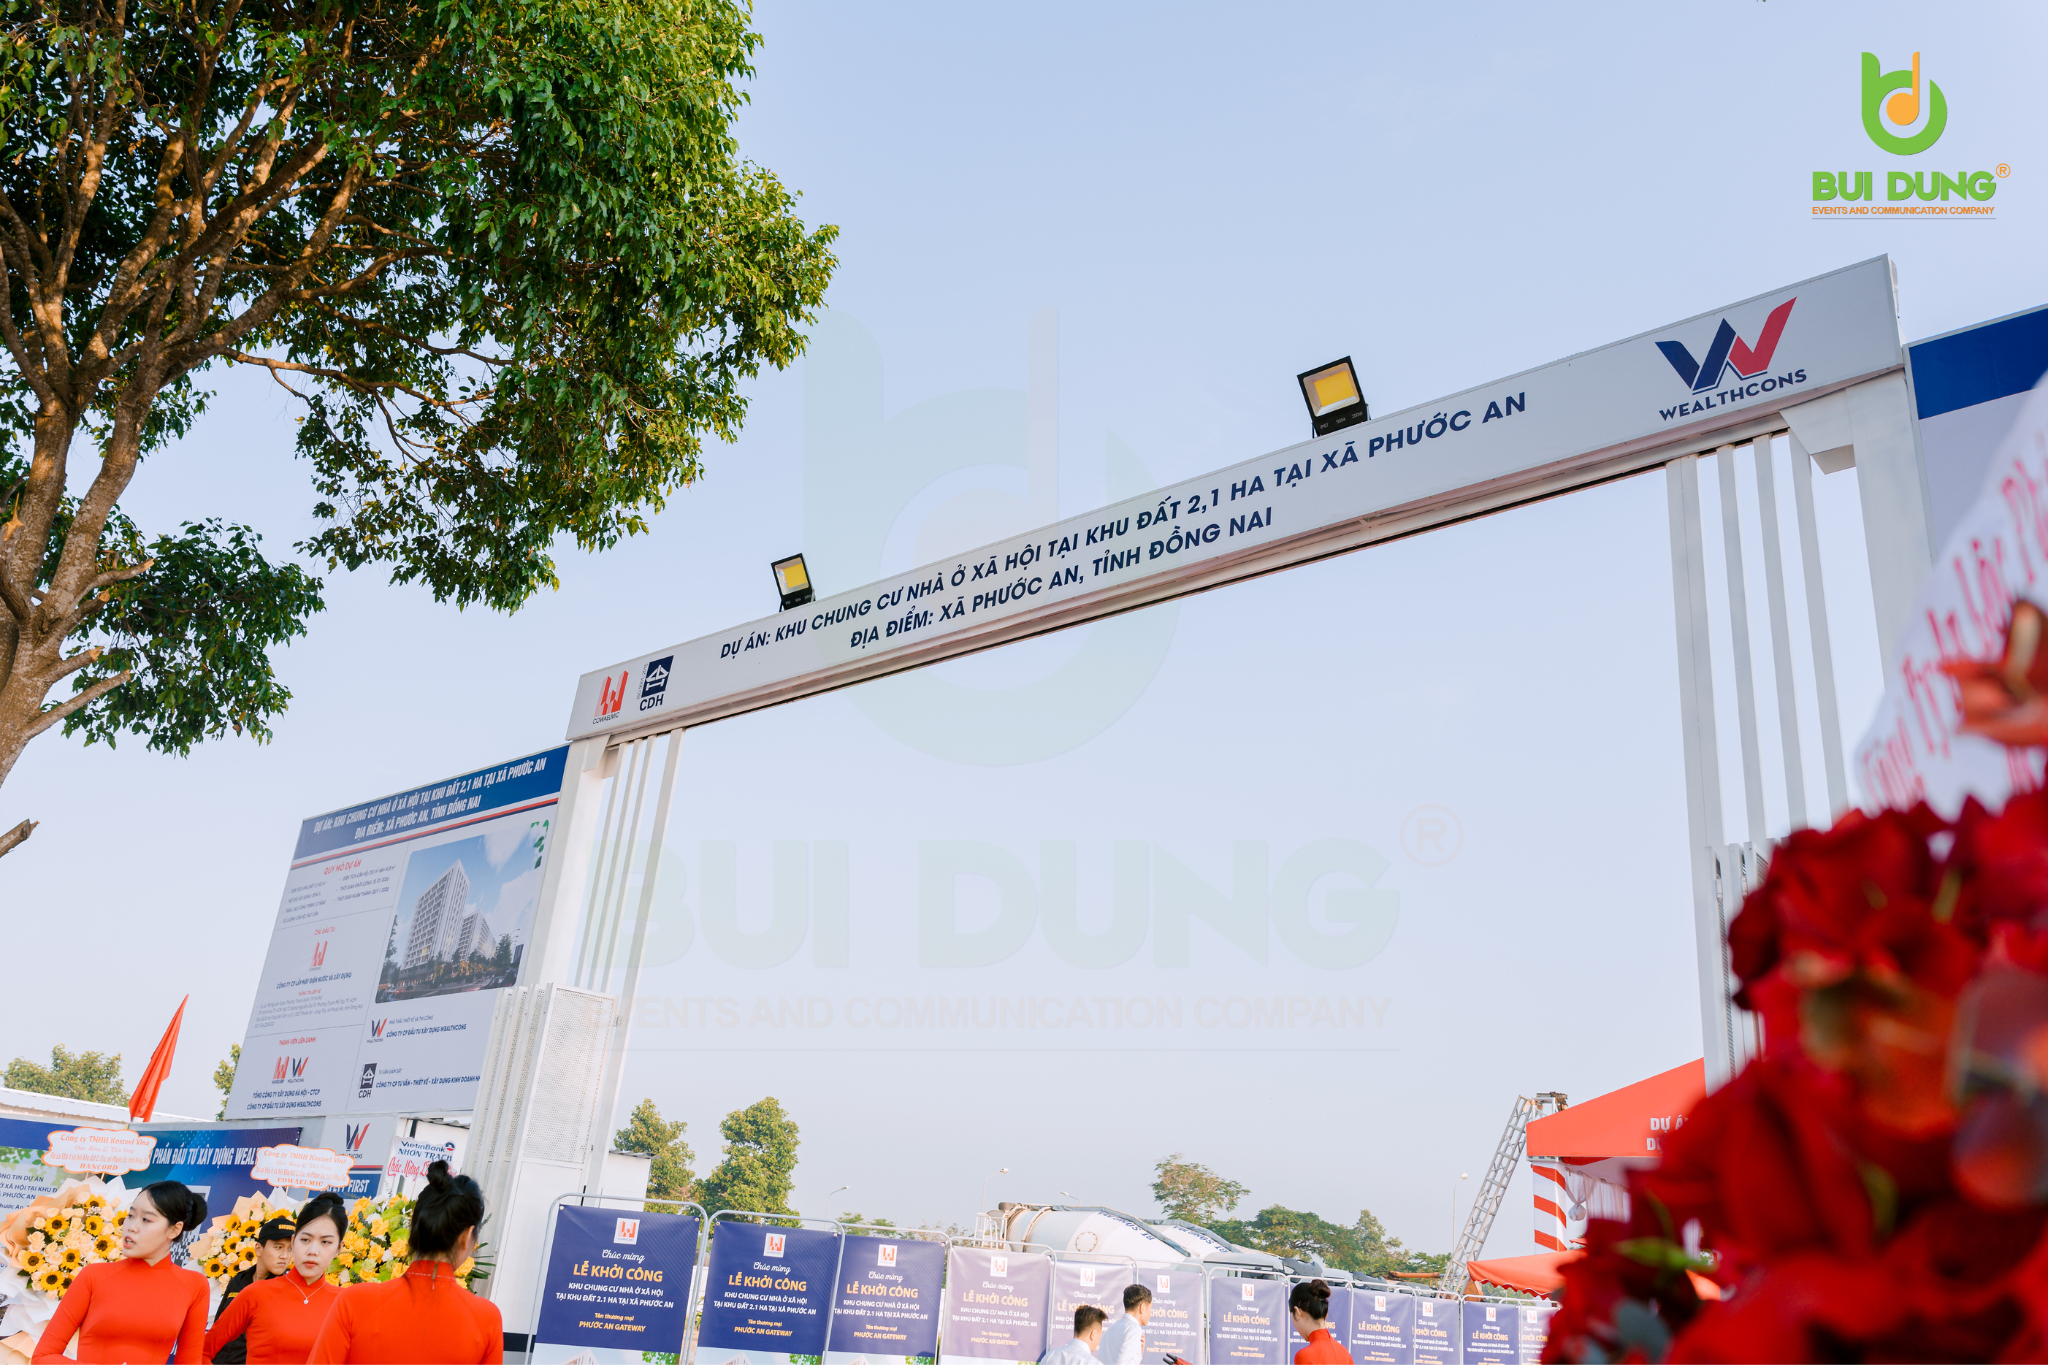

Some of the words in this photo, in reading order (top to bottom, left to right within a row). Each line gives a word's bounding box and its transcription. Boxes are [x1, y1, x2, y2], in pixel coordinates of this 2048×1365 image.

[1659, 368, 1807, 422] WEALTHCONS
[720, 636, 744, 659] DỰ
[744, 631, 771, 651] ÁN:
[775, 619, 807, 643] KHU
[811, 597, 871, 631] CHUNG
[876, 587, 904, 609] CƯ
[906, 572, 945, 601] NHÀ
[951, 564, 967, 587] Ở
[970, 557, 998, 582] XÃ
[1005, 544, 1042, 571] HỘI
[1048, 533, 1080, 557] TẠI
[1085, 518, 1130, 546] KHU
[1136, 498, 1182, 530] ĐẤT
[1188, 489, 1220, 516] 2,1
[1231, 476, 1265, 501] HA
[1274, 460, 1312, 488] TẠI
[1320, 441, 1359, 473] XÃ
[1369, 410, 1472, 458] PHƯỚC
[1482, 392, 1526, 424] AN
[850, 626, 880, 649] ĐỊA
[886, 605, 934, 638] ĐIỂM:
[939, 596, 966, 623] XÃ
[972, 576, 1043, 613] PHƯỚC
[1048, 565, 1084, 590] AN,
[1092, 549, 1141, 577] TỈNH
[1149, 522, 1220, 560] ĐỒNG
[1229, 507, 1272, 537] NAI
[640, 693, 664, 712] CDH
[313, 819, 325, 835] DỰ
[322, 817, 333, 831] ÁN:
[333, 814, 347, 828] KHU
[346, 808, 368, 824] CHUNG
[367, 804, 378, 818] CƯ
[377, 800, 391, 816] NHÀ
[391, 796, 398, 812] Ở
[397, 795, 408, 811] XÃ
[407, 792, 420, 809] HỘI
[419, 790, 432, 806] TẠI
[431, 785, 446, 801] KHU
[445, 779, 461, 796] ĐẤT
[459, 779, 472, 793] 2,1
[472, 776, 483, 790] HA
[483, 772, 497, 788] TẠI
[495, 766, 508, 784] XÃ
[507, 759, 534, 780] PHƯỚC
[533, 757, 547, 773] AN
[354, 826, 366, 841] ĐỊA
[366, 818, 385, 836] ĐIỂM:
[384, 816, 395, 832] XÃ
[395, 811, 418, 829] PHƯỚC
[417, 809, 429, 823] AN,
[430, 802, 447, 819] TỈNH
[446, 797, 467, 815] ĐỒNG
[467, 795, 482, 810] NAI
[1650, 1116, 1671, 1133] DỰ
[1675, 1114, 1689, 1130] Á
[61, 1134, 78, 1143] Công
[111, 1137, 134, 1145] Kosteel
[136, 1138, 150, 1146] Vina
[401, 1140, 446, 1152] VietinBank
[171, 1142, 188, 1164] ĐẦU
[187, 1146, 199, 1165] TƯ
[197, 1144, 214, 1165] XÂY
[212, 1146, 234, 1169] DỰNG
[264, 1150, 279, 1158] Công
[310, 1155, 332, 1163] Kosteel
[398, 1148, 421, 1157] NHƠN
[425, 1152, 452, 1162] TRẠCH
[277, 1178, 323, 1186] COWAELMIC
[348, 1180, 370, 1192] FIRST
[2, 1191, 25, 1199] PHƯỚC
[601, 1249, 622, 1260] Chúc
[573, 1260, 590, 1277] LỄ
[590, 1263, 623, 1279] KHỞI
[626, 1267, 663, 1283] CÔNG
[753, 1261, 771, 1271] Chúc
[728, 1271, 743, 1286] LỄ
[743, 1274, 772, 1289] KHỞI
[774, 1277, 807, 1292] CÔNG
[568, 1282, 583, 1290] KHU
[583, 1283, 608, 1292] CHUNG
[608, 1285, 619, 1293] CƯ
[619, 1285, 634, 1294] NHÀ
[634, 1286, 641, 1295] Ở
[641, 1287, 650, 1296] XÃ
[651, 1288, 663, 1297] HỘI
[846, 1281, 859, 1295] LỄ
[860, 1283, 887, 1296] KHỞI
[888, 1286, 919, 1299] CÔNG
[555, 1292, 567, 1302] TẠI
[567, 1293, 582, 1301] KHU
[582, 1293, 596, 1302] ĐẤT
[618, 1298, 629, 1307] TẠI
[629, 1297, 639, 1306] XÃ
[639, 1299, 663, 1308] PHƯỚC
[963, 1290, 975, 1302] LỄ
[976, 1292, 1000, 1304] KHỞI
[1001, 1295, 1028, 1307] CÔNG
[604, 1313, 624, 1321] thương
[579, 1320, 603, 1329] PHƯỚC
[603, 1322, 614, 1330] AN
[614, 1324, 646, 1332] GATEWAY
[734, 1326, 756, 1334] PHƯỚC
[765, 1329, 793, 1337] GATEWAY
[853, 1331, 873, 1339] PHƯỚC
